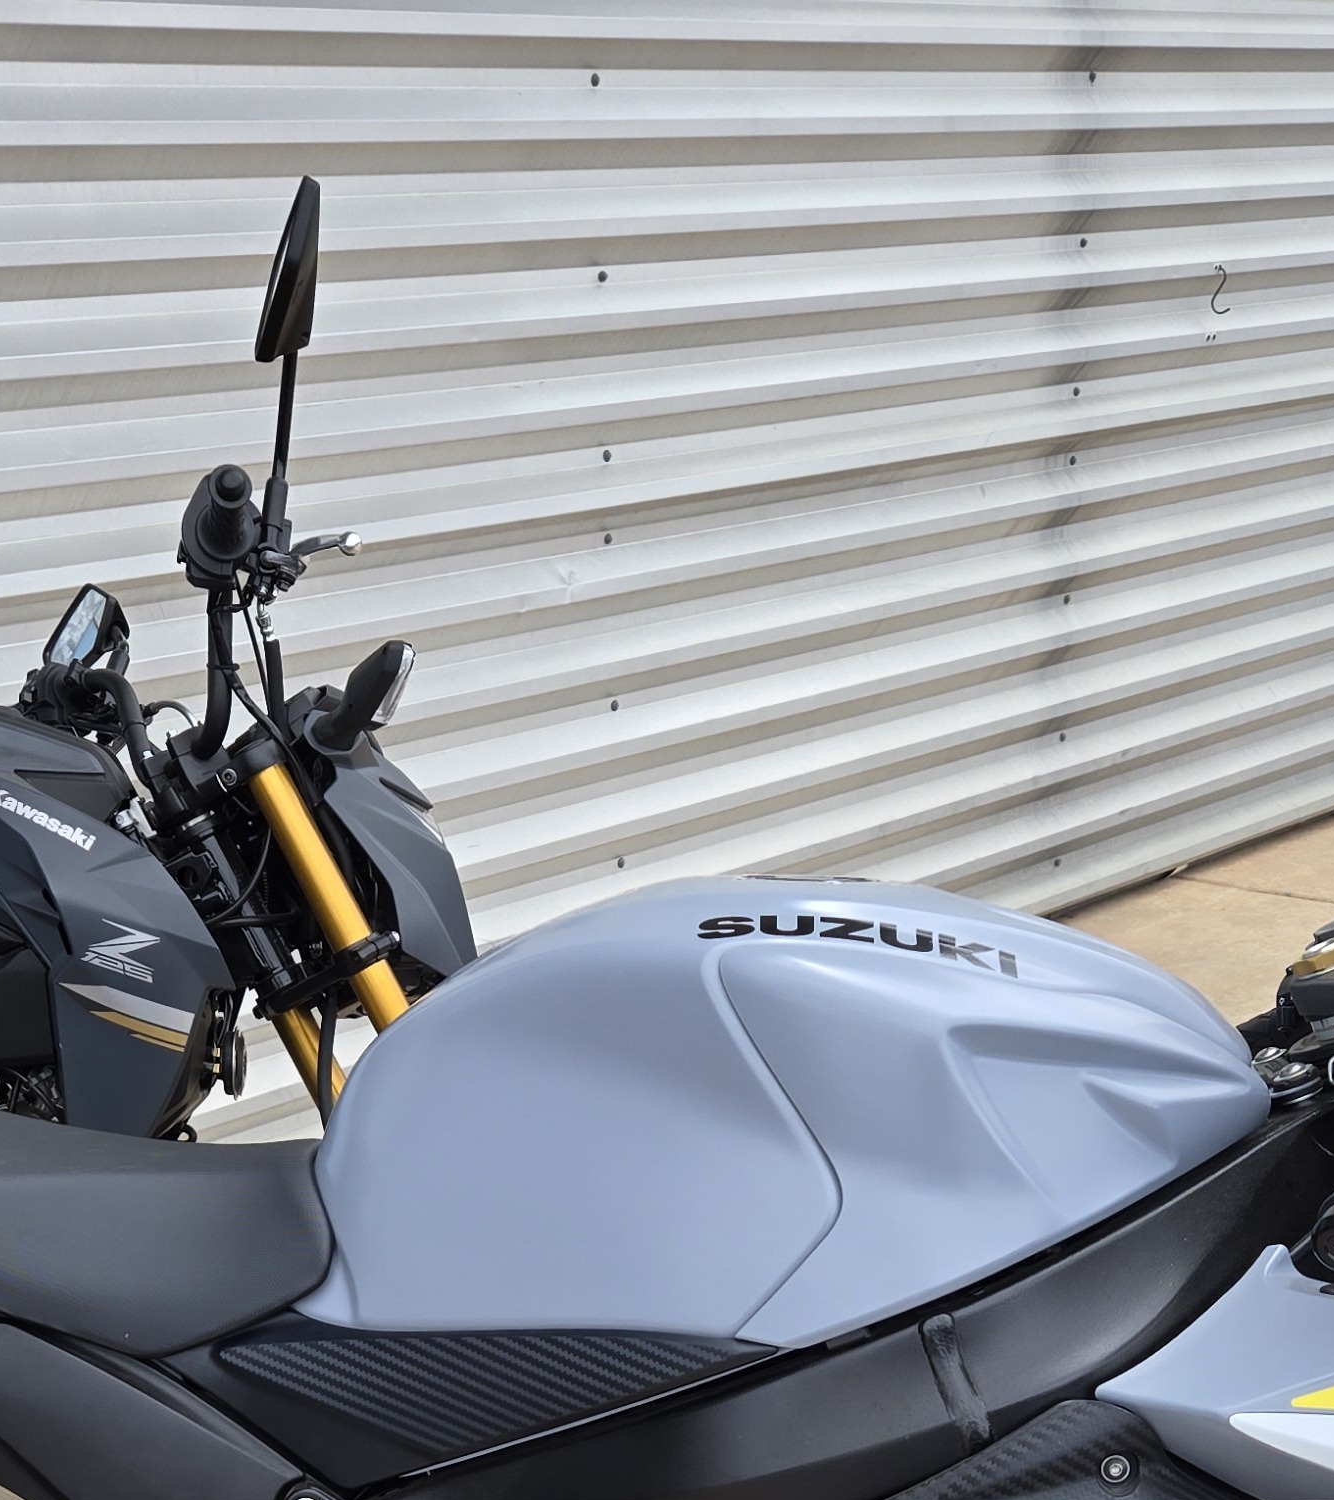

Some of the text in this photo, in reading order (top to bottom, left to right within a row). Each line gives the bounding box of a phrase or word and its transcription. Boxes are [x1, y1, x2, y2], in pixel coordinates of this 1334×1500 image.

[80, 951, 154, 984] 125
[88, 918, 161, 971] Z
[696, 914, 1019, 980] SUZUKI
